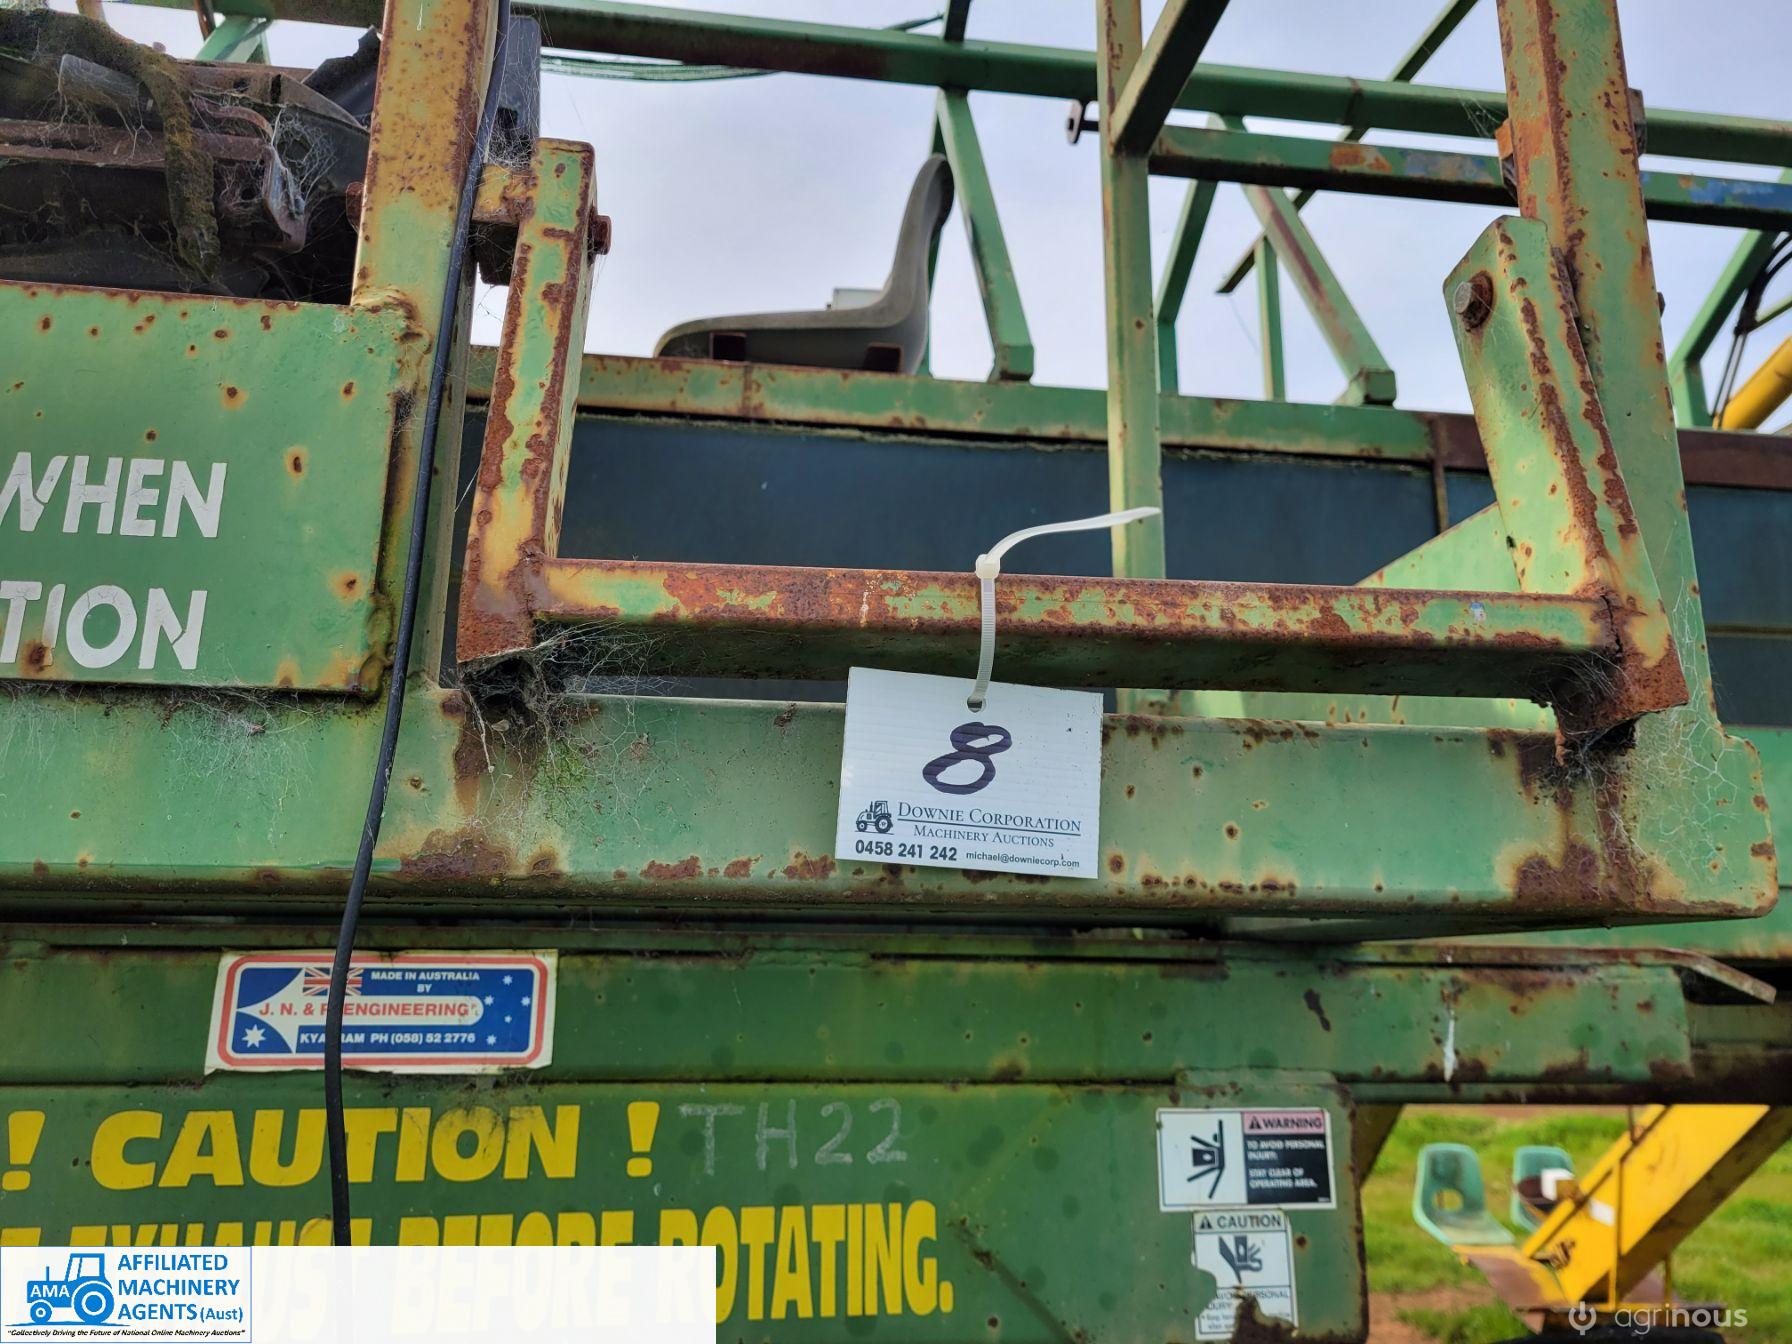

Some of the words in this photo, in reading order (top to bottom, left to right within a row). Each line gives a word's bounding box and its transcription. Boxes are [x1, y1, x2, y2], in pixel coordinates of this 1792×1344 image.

[922, 722, 1012, 795] 8
[898, 802, 964, 822] DOWNIE
[969, 808, 1081, 832] CORPORATION
[913, 825, 989, 841] MACHINERY
[992, 832, 1055, 848] AUCTIONS
[855, 840, 893, 857] 0458
[898, 843, 923, 858] 241
[929, 846, 957, 861] 242
[966, 851, 1080, 868] michael@downiecorp.com
[371, 971, 402, 981] MADE
[404, 971, 417, 981] IN
[418, 971, 480, 981] AUSTRALIA
[416, 983, 432, 993] BY
[259, 1003, 274, 1016] J.
[280, 1003, 297, 1016] N.
[303, 1002, 315, 1016] &
[343, 1003, 469, 1016] ENGINEERING
[370, 1033, 389, 1043] PH
[425, 1033, 442, 1043] 52
[1262, 1117, 1322, 1129] WARNING
[678, 1096, 907, 1177] TH22
[90, 1105, 581, 1191] CAUTION
[1216, 1214, 1282, 1229] CAUTION
